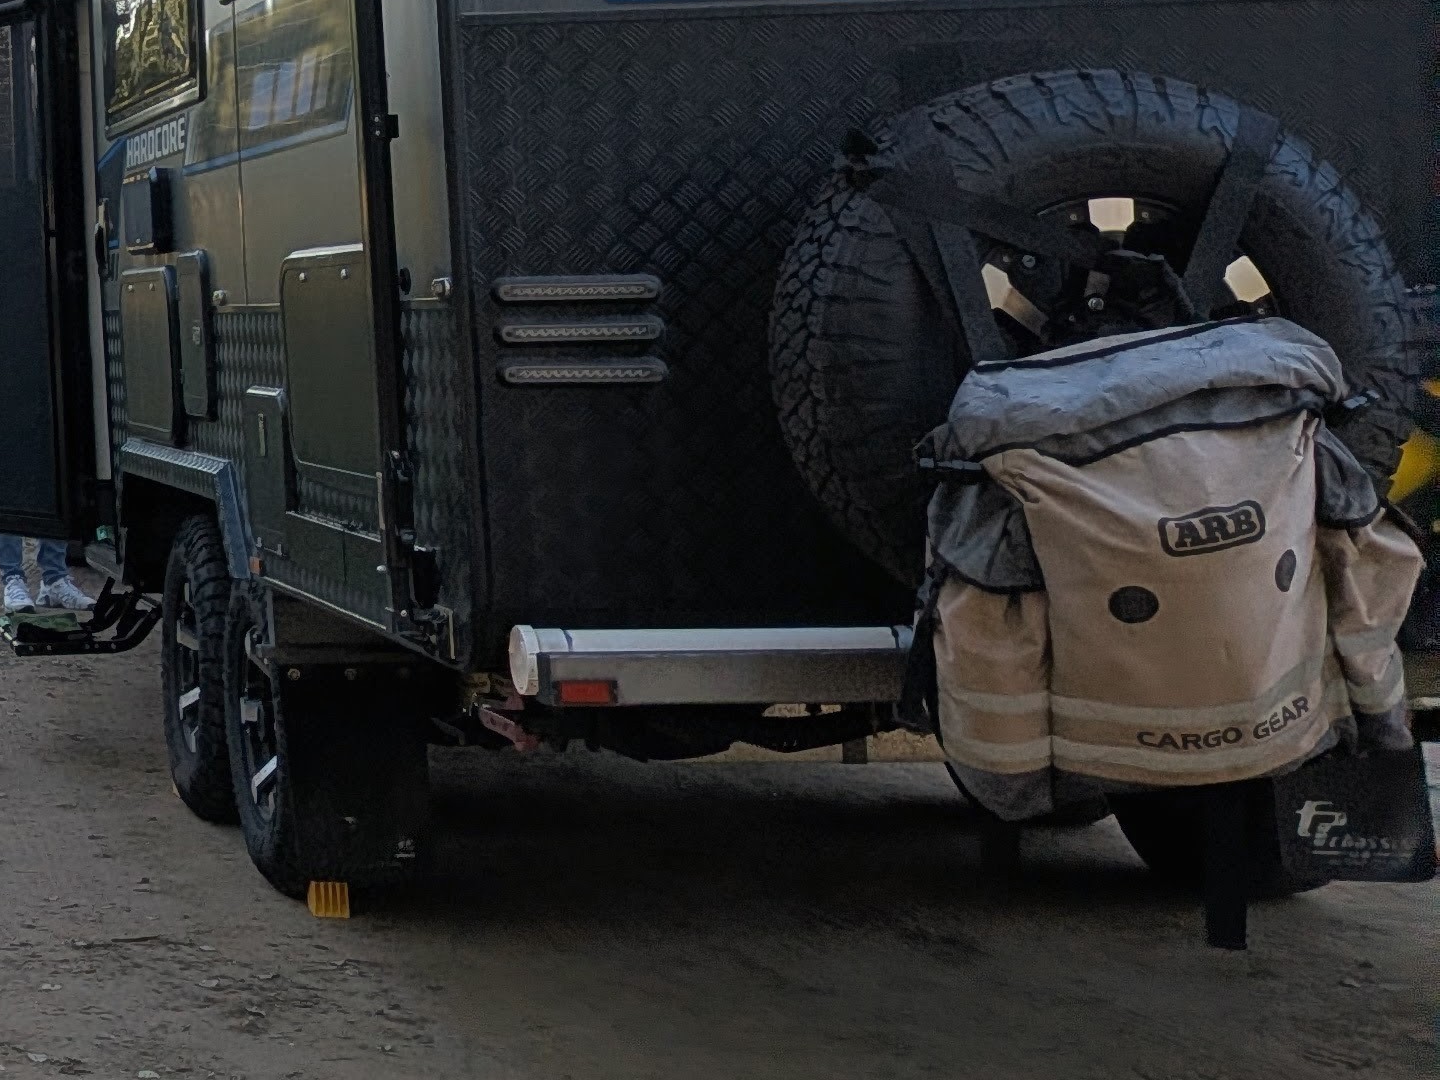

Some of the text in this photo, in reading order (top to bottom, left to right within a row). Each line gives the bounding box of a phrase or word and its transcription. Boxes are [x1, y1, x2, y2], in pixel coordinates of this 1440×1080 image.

[126, 117, 185, 169] HARDCORE
[1174, 509, 1258, 548] ARB
[1137, 696, 1309, 750] CARGO GEAR
